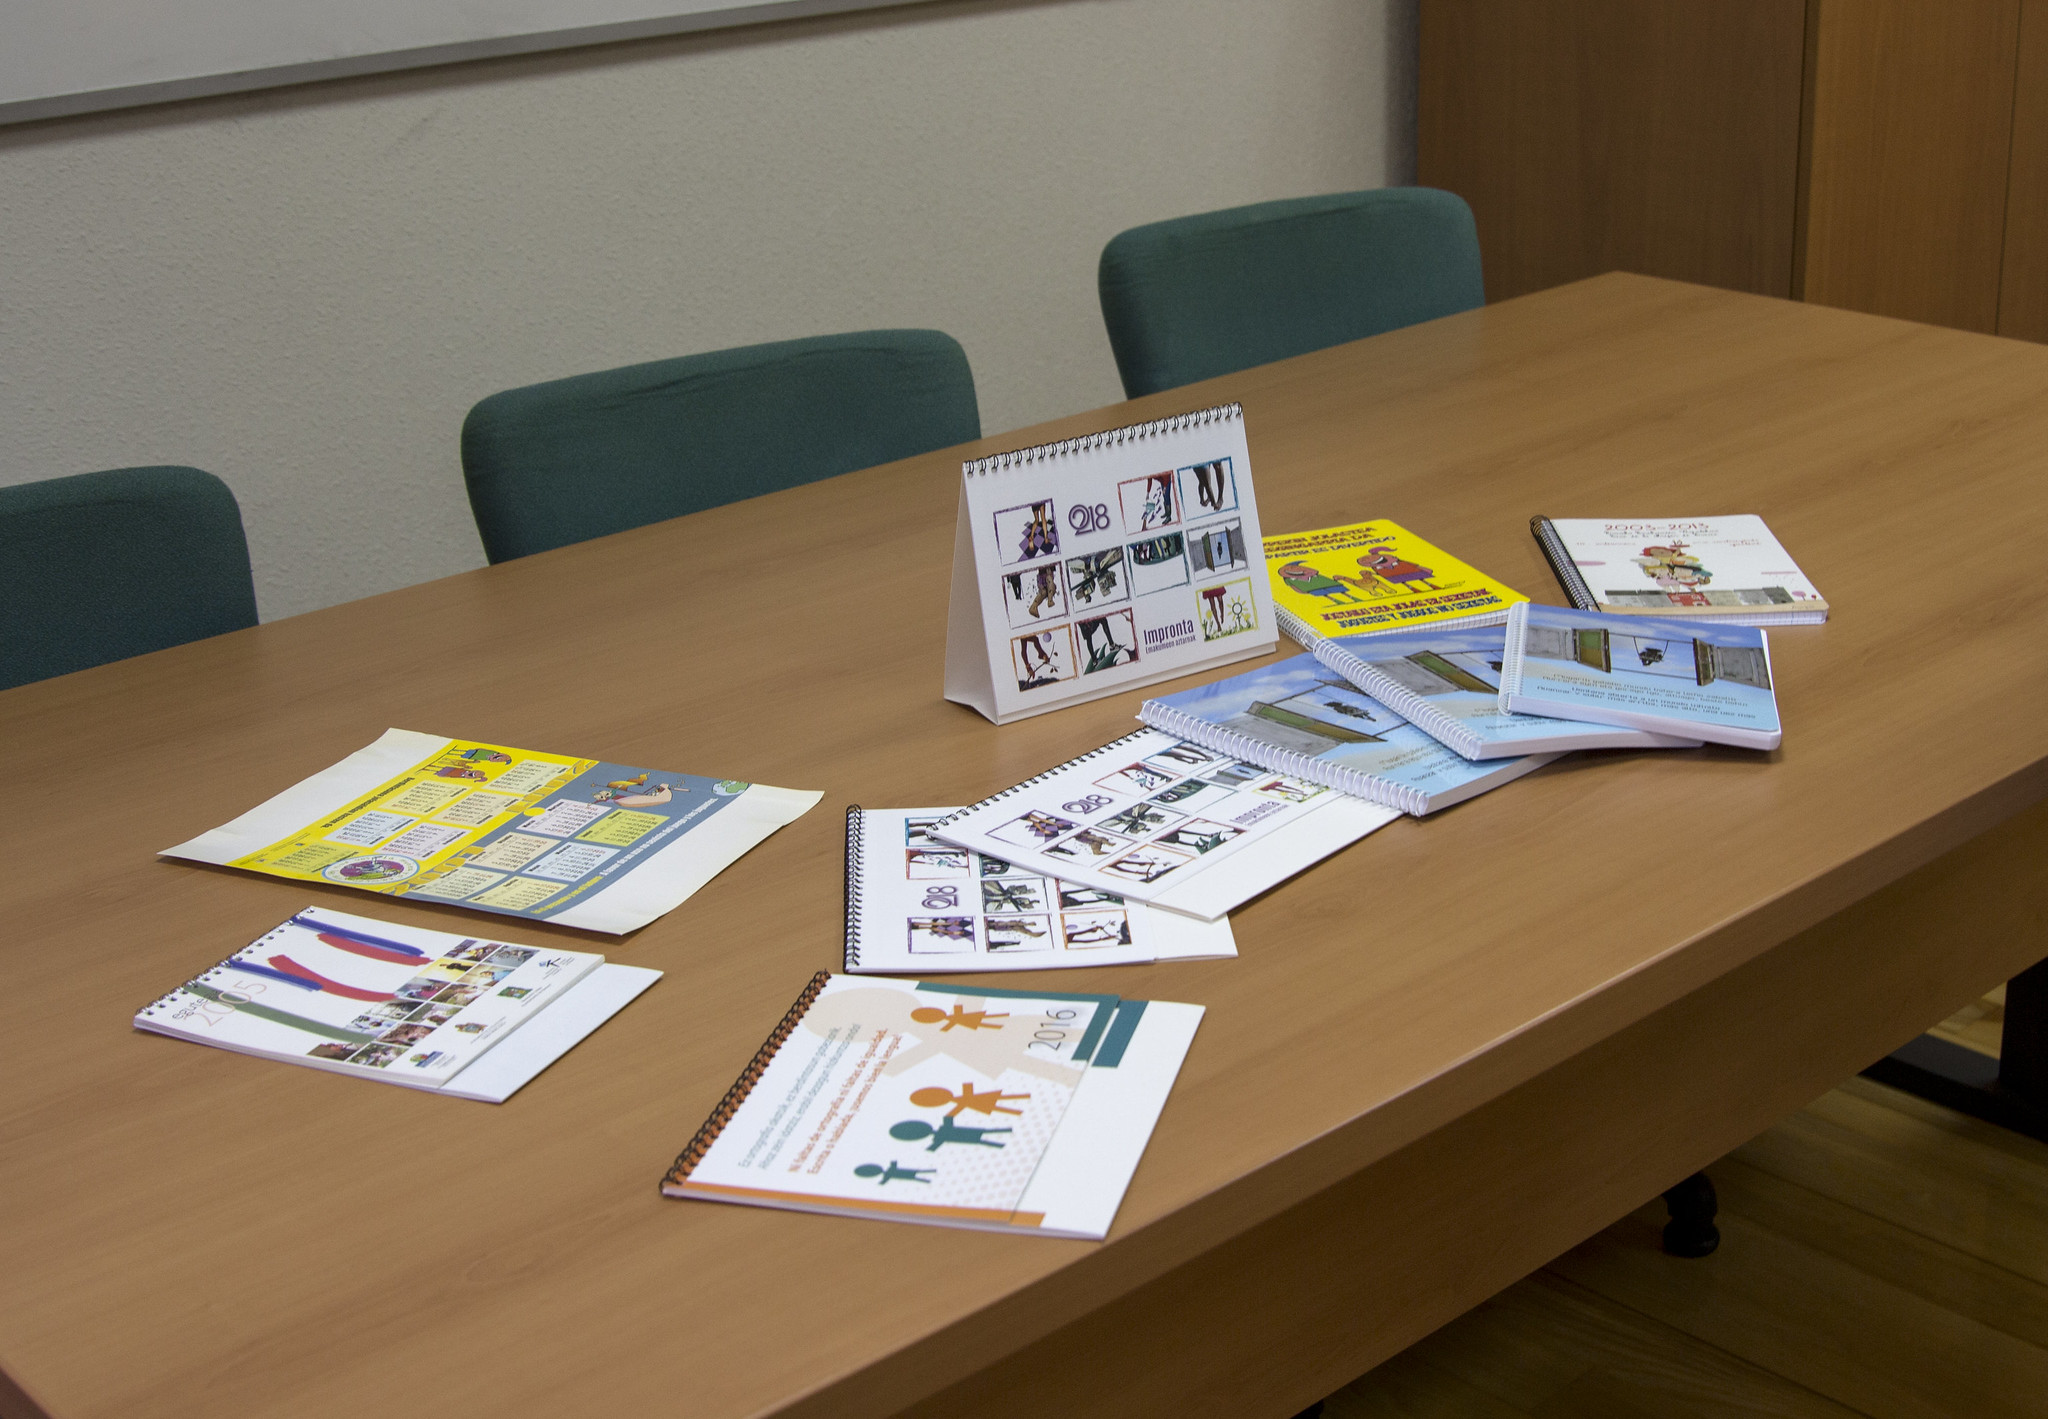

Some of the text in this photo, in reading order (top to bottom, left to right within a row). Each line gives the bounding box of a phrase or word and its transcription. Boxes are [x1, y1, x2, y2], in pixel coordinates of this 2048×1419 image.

[1143, 619, 1194, 645] Impronta
[1229, 800, 1281, 825] Impronta
[183, 980, 267, 1027] 2005
[1028, 1009, 1077, 1052] 2016
[793, 1142, 814, 1163] faltas
[807, 1132, 821, 1141] de
[842, 1069, 861, 1088] faltas
[855, 1059, 867, 1068] de
